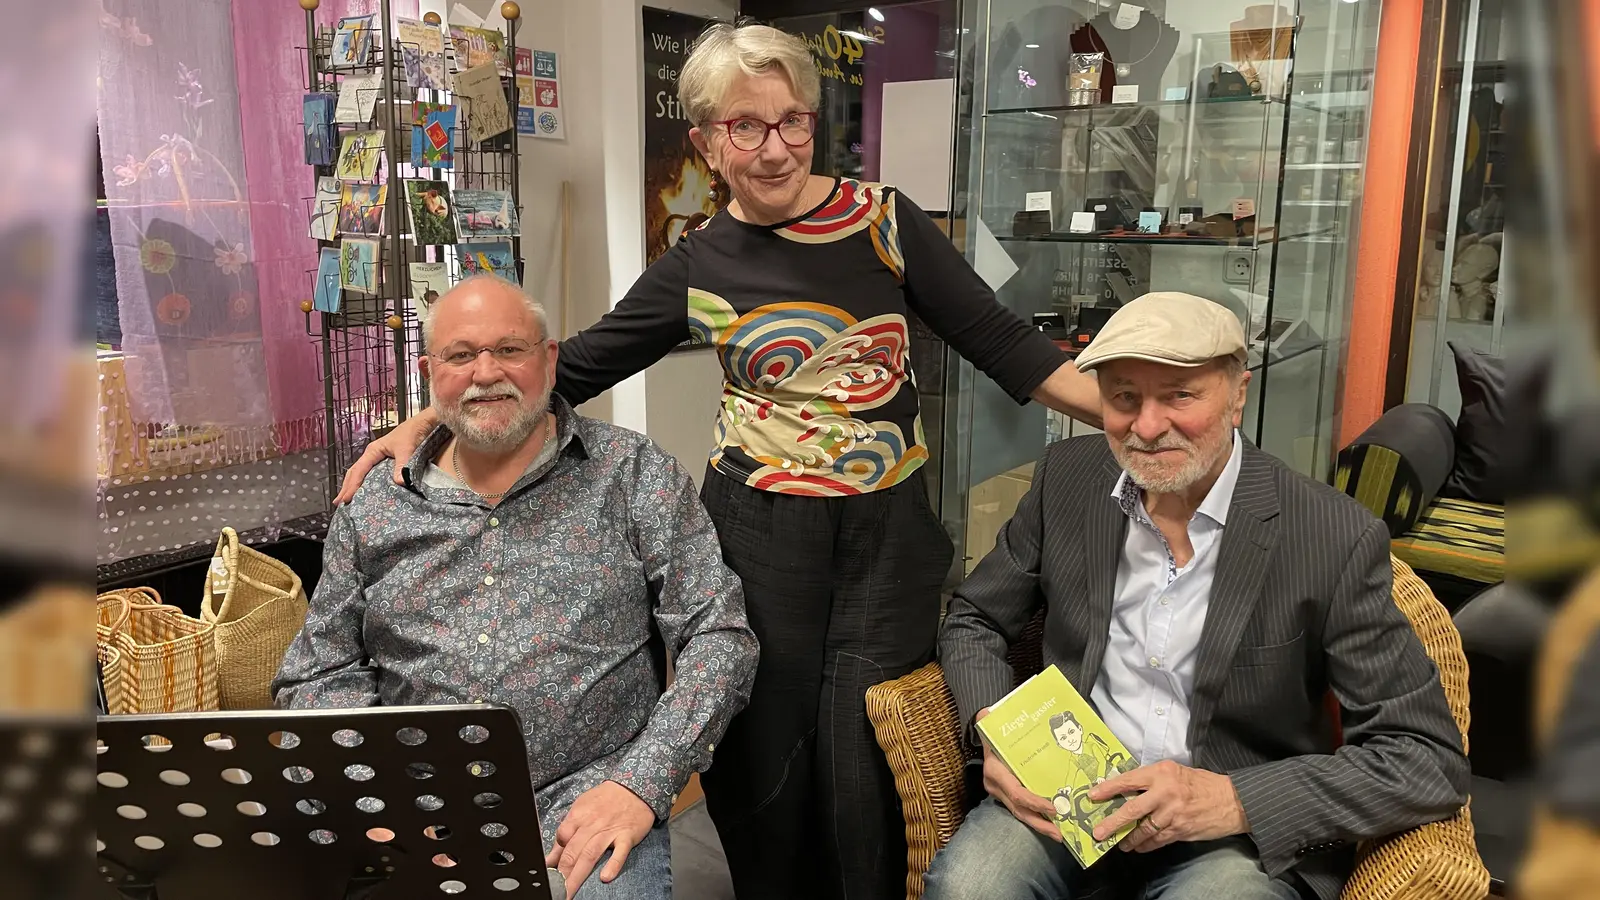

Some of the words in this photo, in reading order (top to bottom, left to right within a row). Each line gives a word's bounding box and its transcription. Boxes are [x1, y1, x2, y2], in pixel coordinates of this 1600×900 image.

[652, 32, 680, 54] Wie
[657, 64, 677, 81] die
[1030, 696, 1057, 722] gassler
[998, 709, 1030, 738] Ziegel
